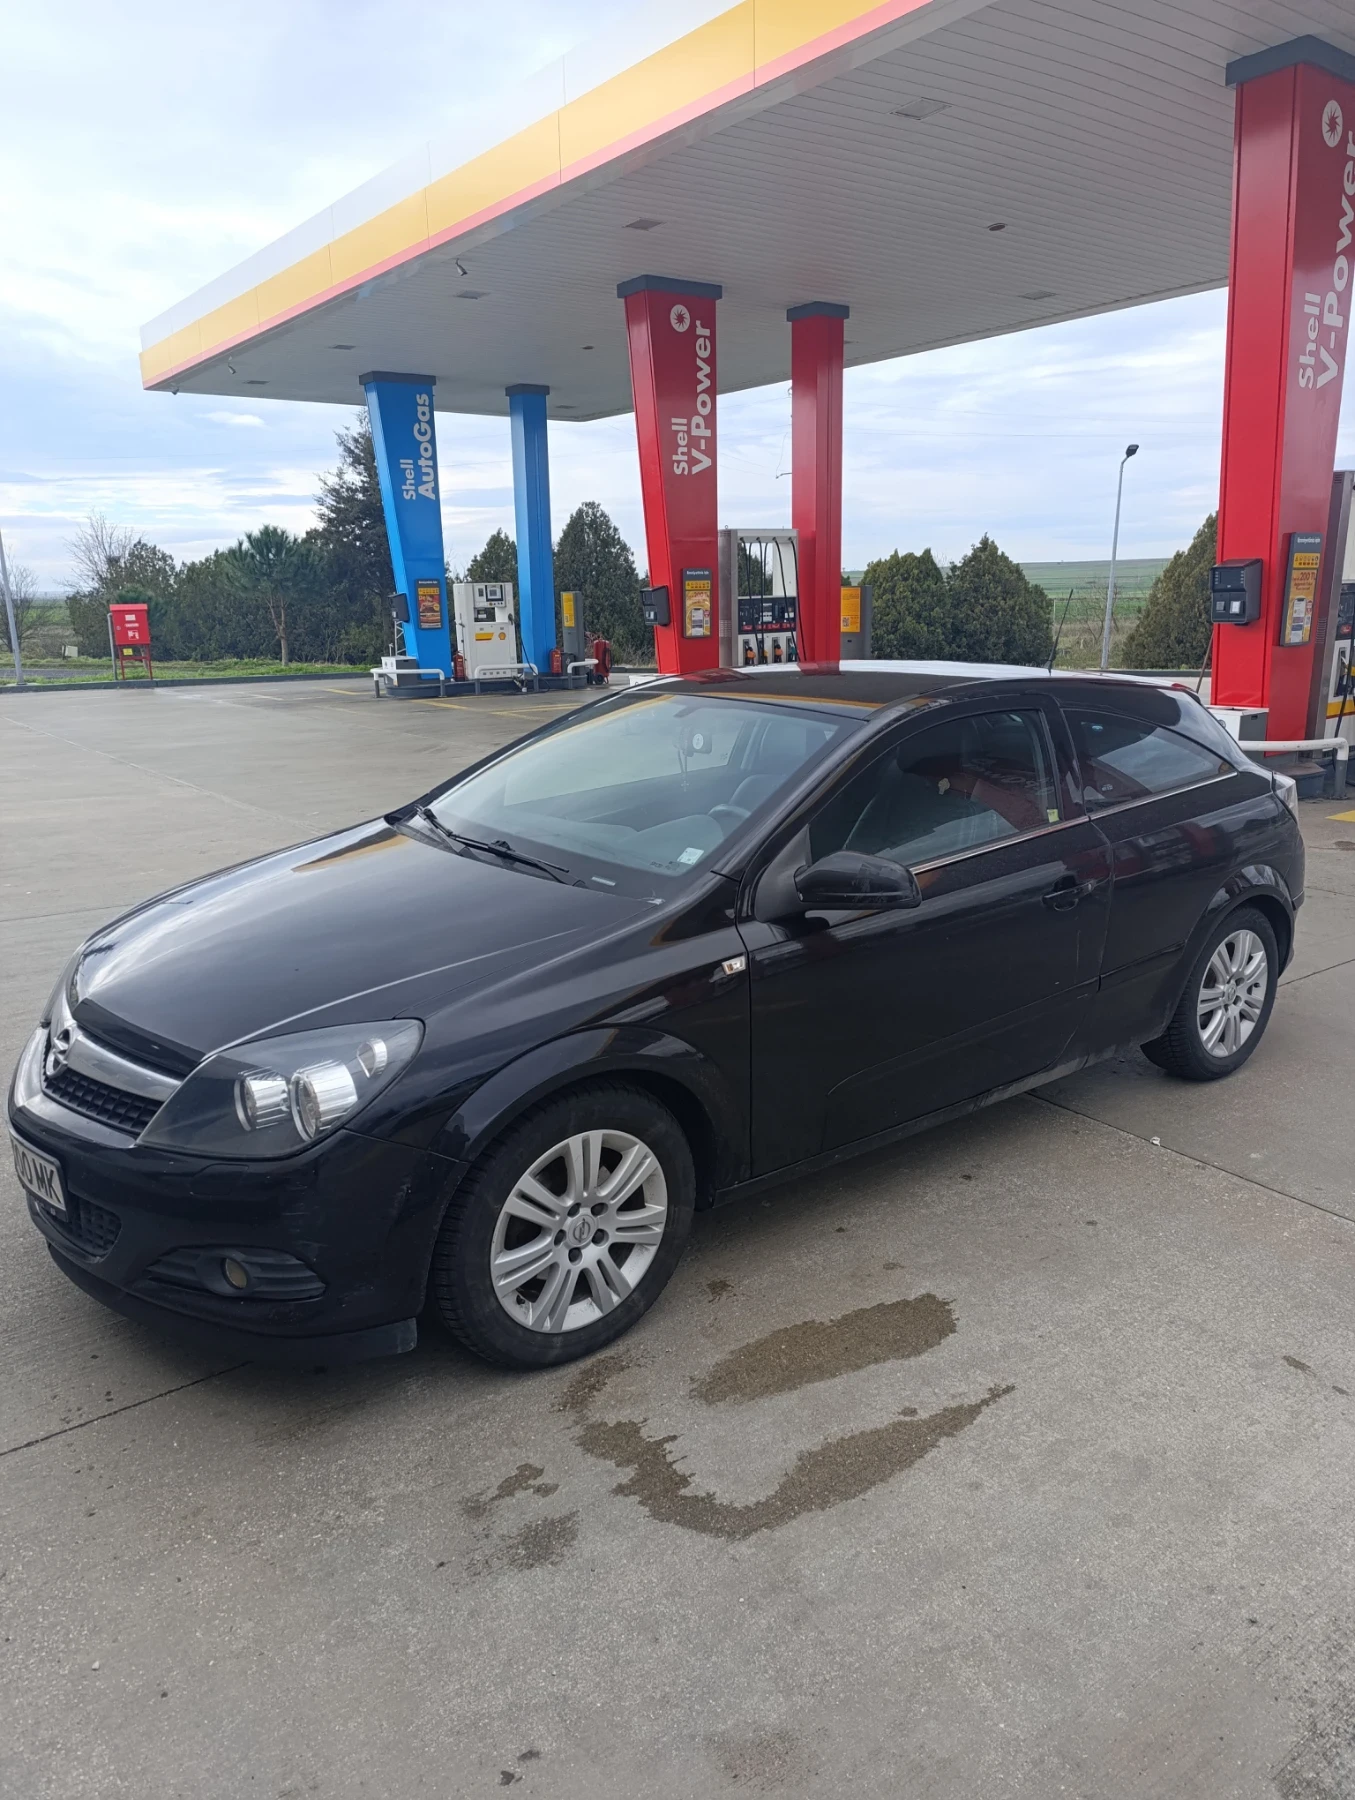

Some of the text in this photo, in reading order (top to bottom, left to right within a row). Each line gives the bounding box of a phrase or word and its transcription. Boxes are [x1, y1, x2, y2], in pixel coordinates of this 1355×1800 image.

[1316, 130, 1355, 389] V-Power
[1299, 292, 1321, 390] Shell
[413, 393, 435, 500] AutoGas
[671, 417, 688, 476] Shell
[690, 320, 712, 475] V-Power
[400, 459, 416, 500] Shell
[32, 1157, 61, 1204] MK
